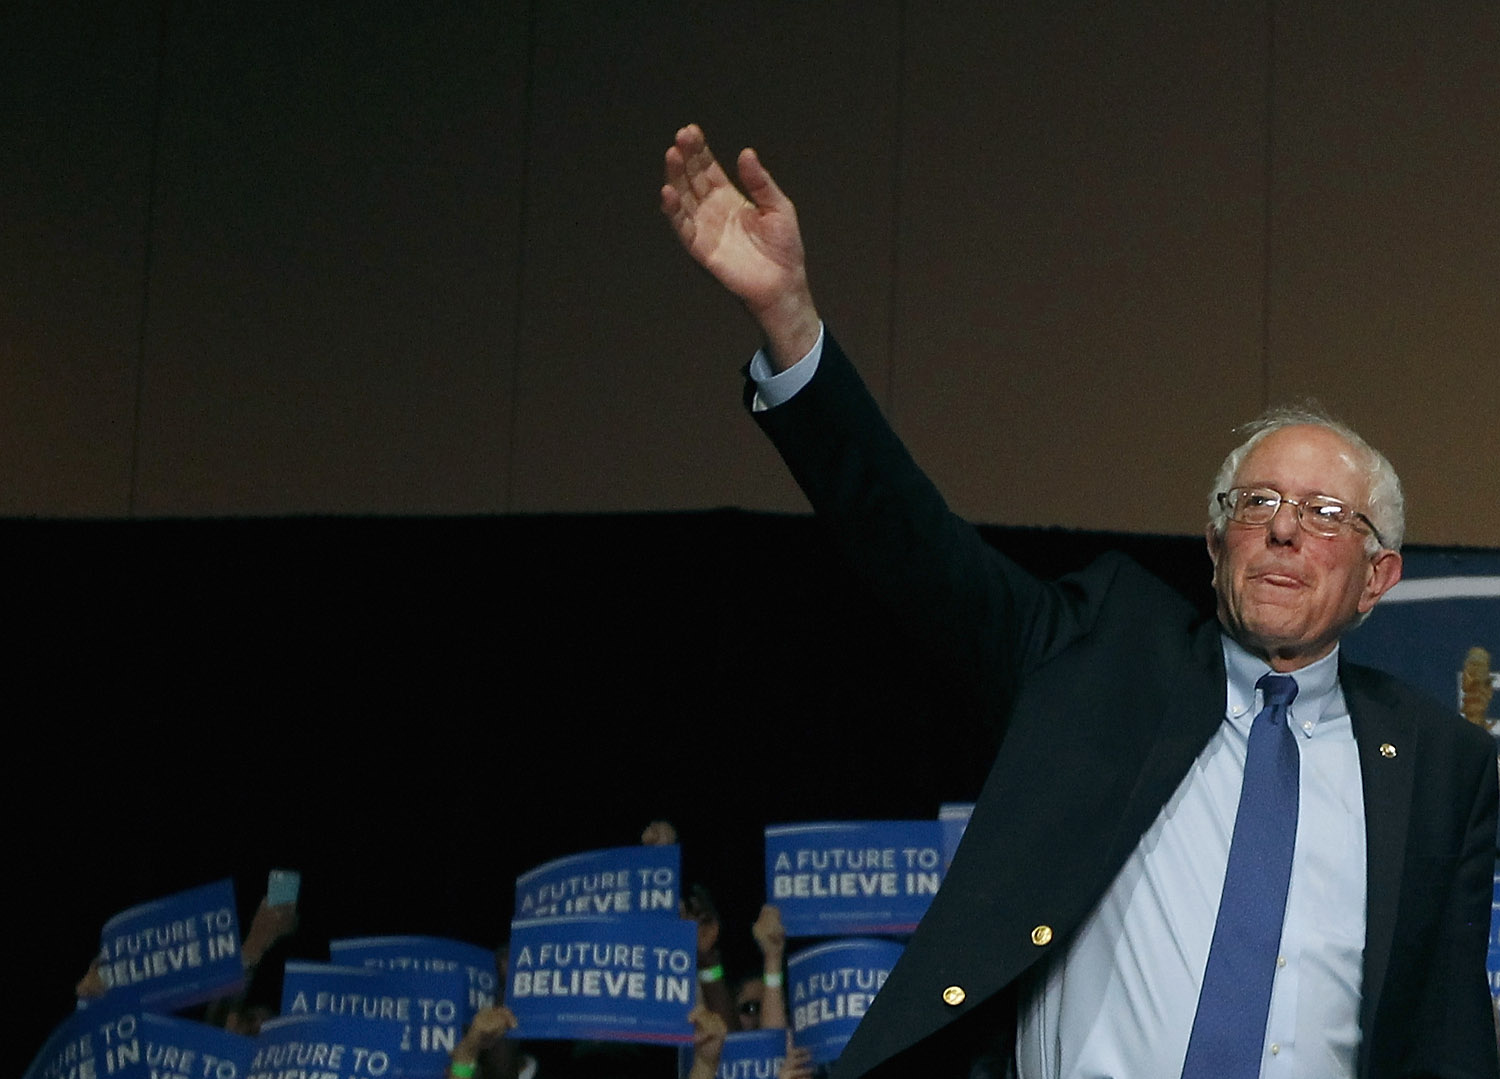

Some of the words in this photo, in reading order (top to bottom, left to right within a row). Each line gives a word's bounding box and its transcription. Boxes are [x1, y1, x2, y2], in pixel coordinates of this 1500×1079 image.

[775, 850, 791, 871] A
[798, 849, 895, 871] FUTURE
[902, 848, 939, 869] TO
[539, 870, 630, 904] FUTURE
[638, 867, 672, 887] TO
[640, 889, 674, 911] IN
[773, 873, 898, 899] BELIEVE
[906, 873, 940, 896] IN
[535, 891, 631, 914] IEVE
[115, 919, 197, 950] FUTURE
[203, 908, 232, 934] TO
[98, 942, 202, 987] BELIEVE
[208, 935, 236, 961] IN
[516, 946, 533, 968] A
[540, 943, 645, 968] FUTURE
[653, 948, 691, 974] TO
[466, 965, 493, 990] TO
[512, 969, 647, 1000] BELIEVE
[655, 975, 691, 1004] IN
[794, 982, 805, 1001] A
[808, 968, 891, 995] FUTUR
[291, 991, 308, 1013] A
[315, 992, 409, 1021] FUTURE
[418, 999, 456, 1023] TO
[793, 991, 876, 1032] BELIE
[100, 1015, 136, 1044] TO
[420, 1026, 456, 1053] IN
[106, 1039, 140, 1076] IN
[146, 1042, 196, 1073] URE
[263, 1042, 345, 1070] FUTURE
[353, 1047, 390, 1077] TO
